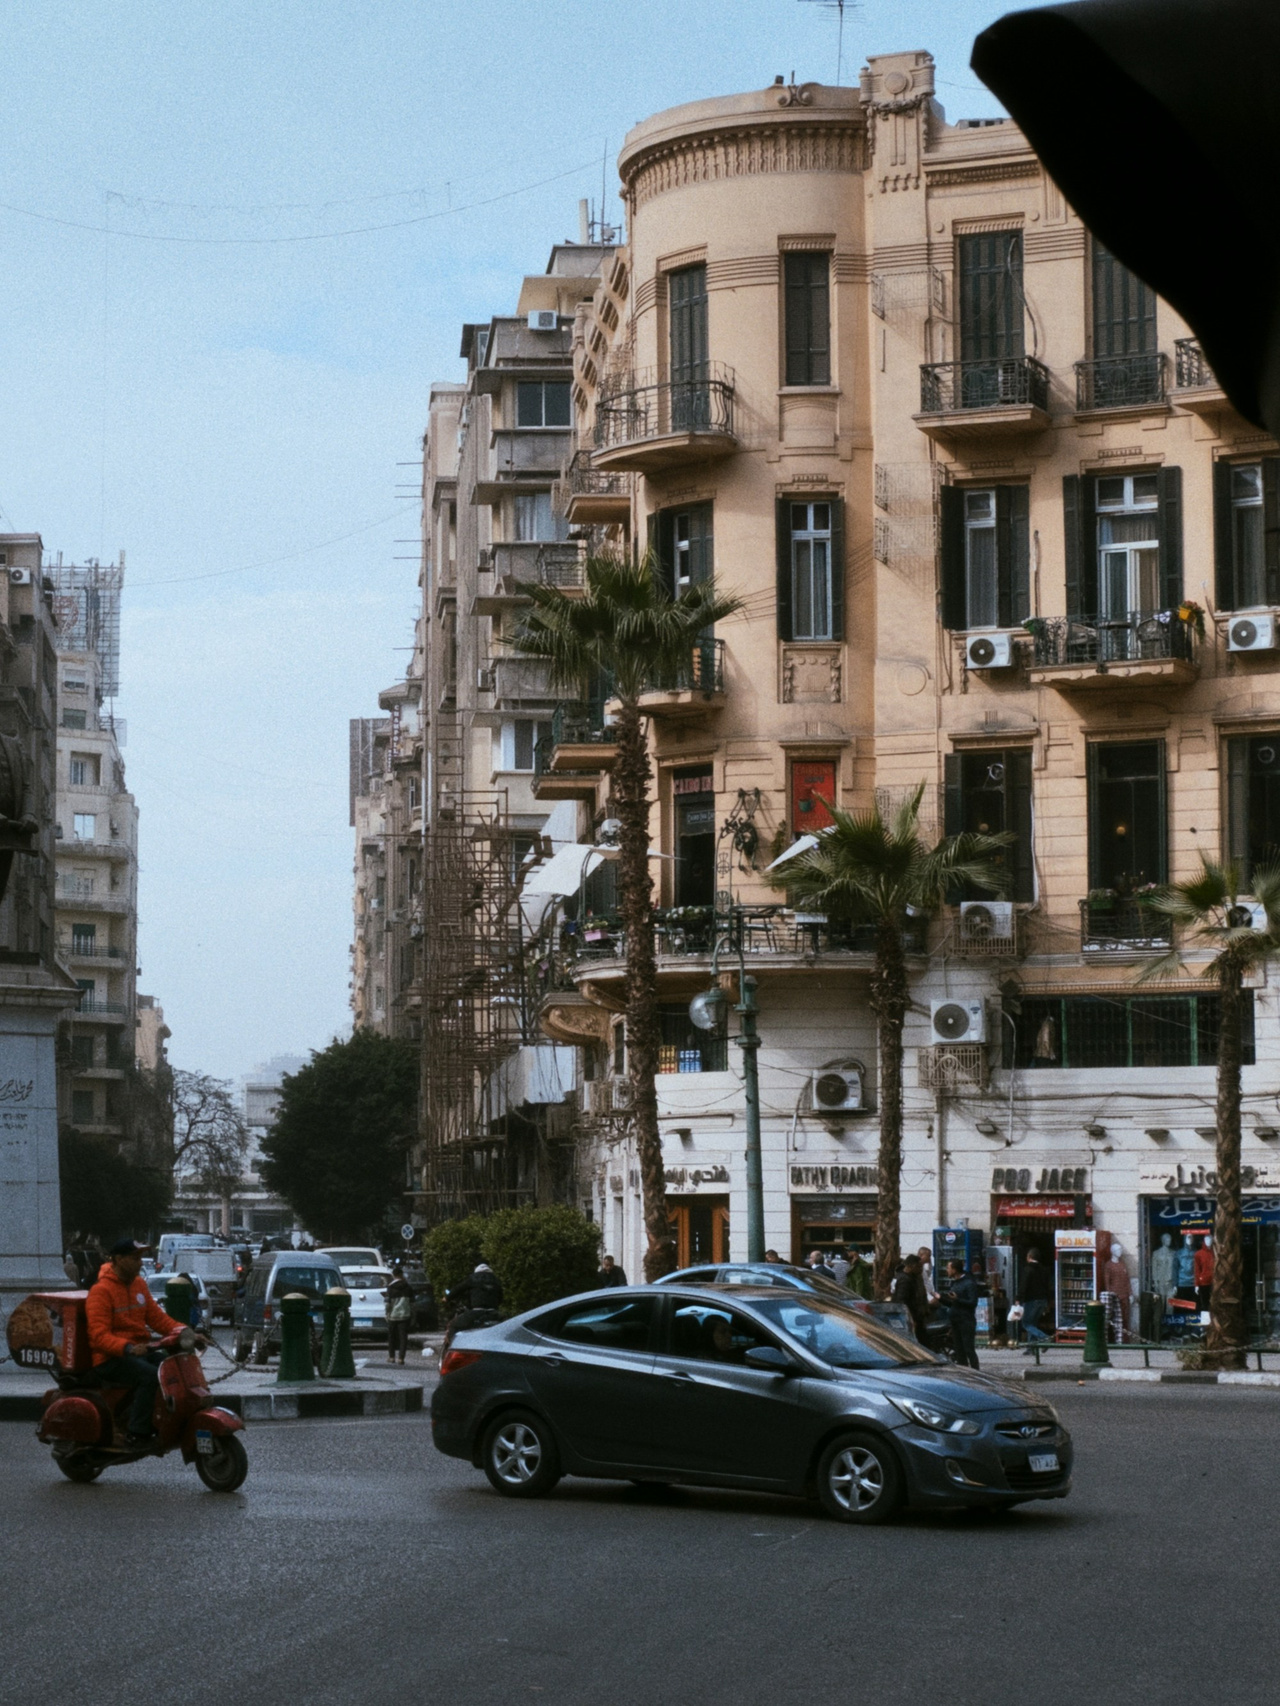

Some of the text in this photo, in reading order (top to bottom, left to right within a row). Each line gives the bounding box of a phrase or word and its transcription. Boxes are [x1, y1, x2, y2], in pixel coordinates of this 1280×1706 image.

[992, 1167, 1087, 1192] PRO JACK
[1074, 1237, 1092, 1245] JACK
[21, 1348, 55, 1366] 16903
